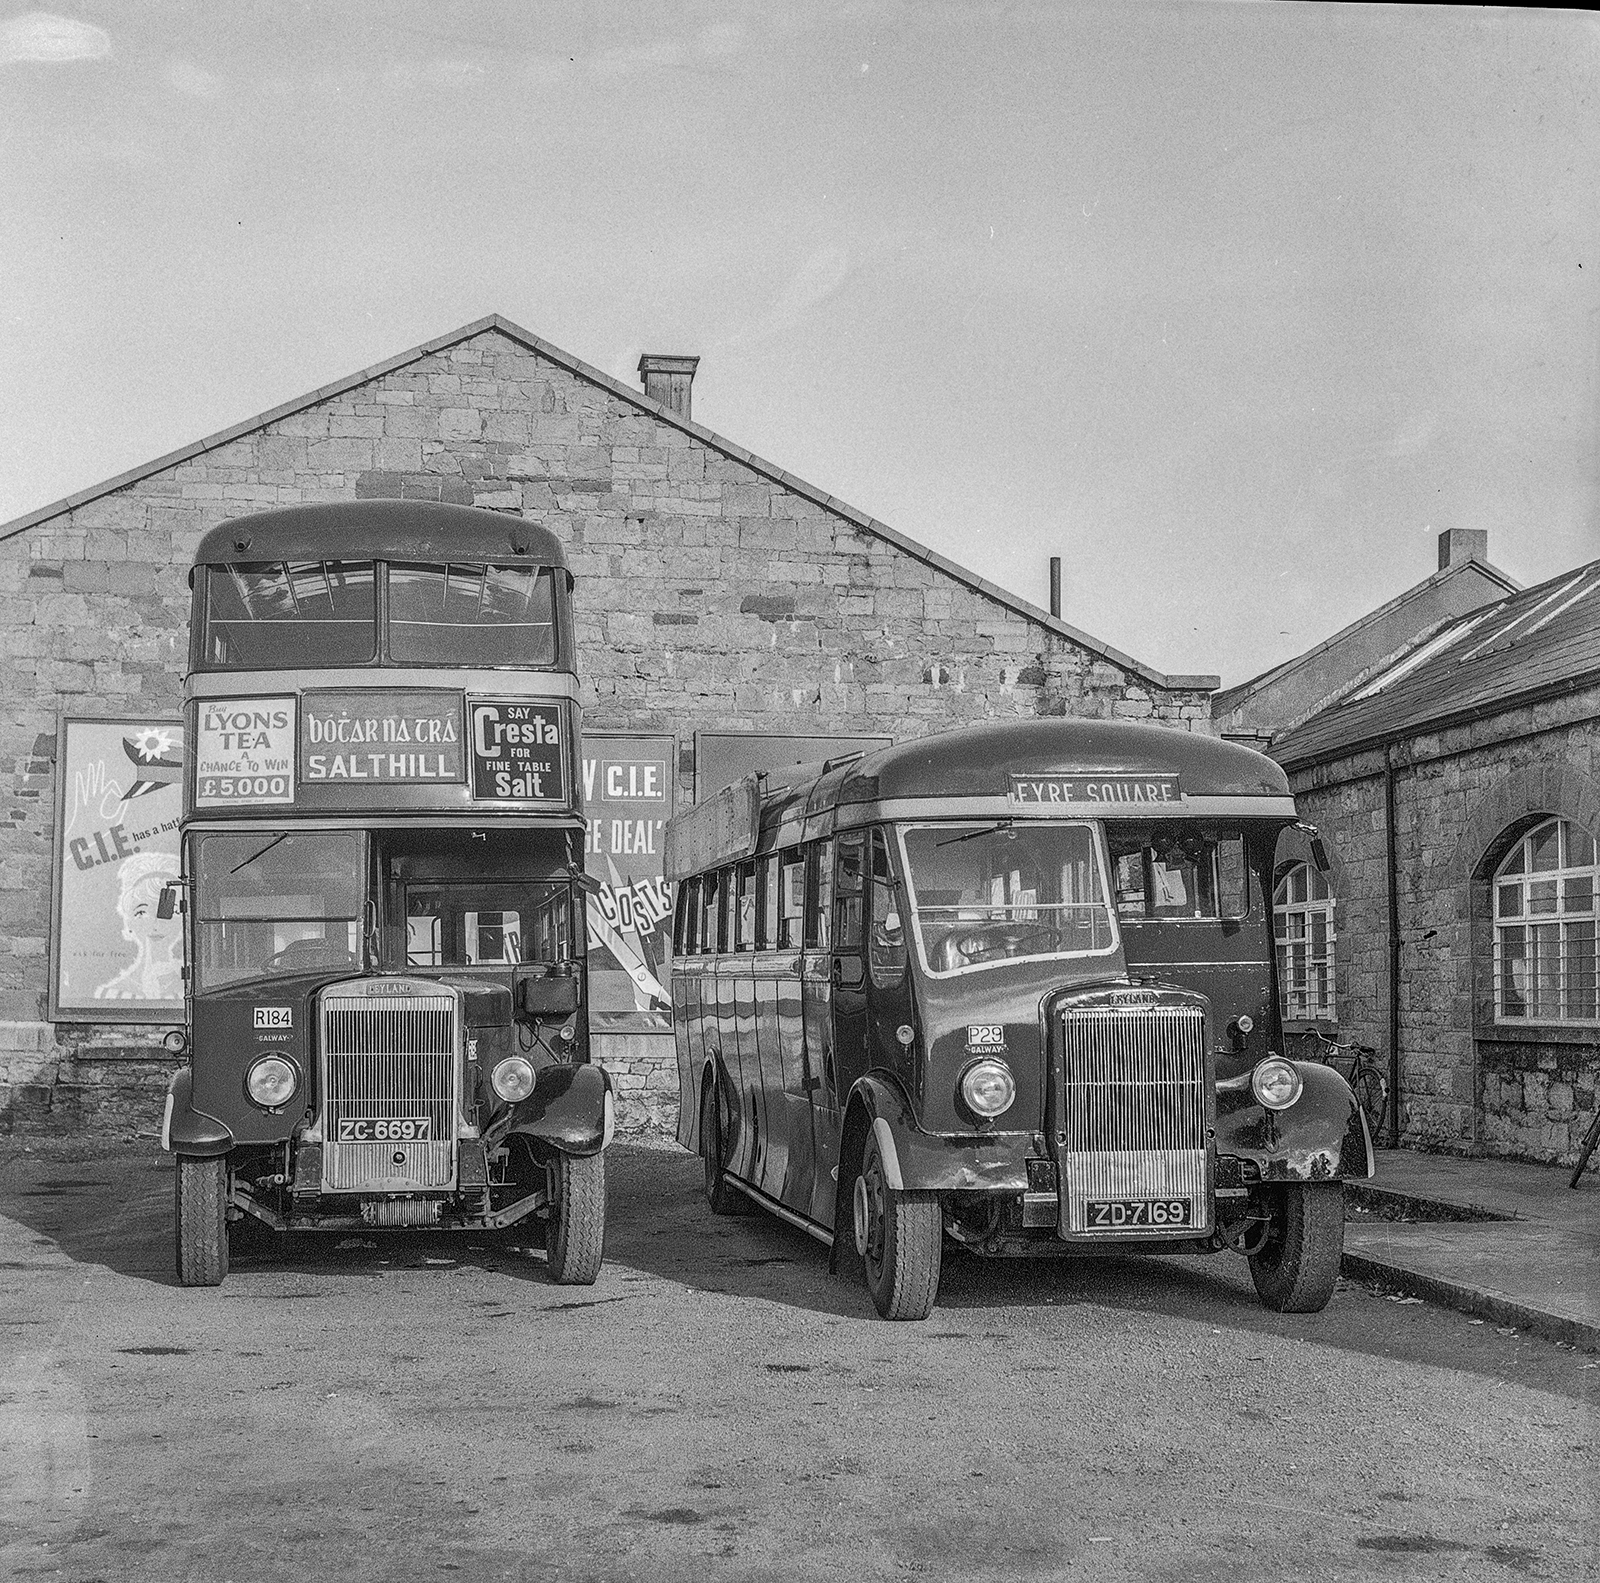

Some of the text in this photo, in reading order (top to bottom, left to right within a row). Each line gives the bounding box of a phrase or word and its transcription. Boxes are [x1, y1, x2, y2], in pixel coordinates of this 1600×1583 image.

[204, 711, 288, 731] LYONS
[507, 707, 530, 719] SAY
[219, 732, 271, 750] TEA
[474, 706, 559, 758] Cresta
[241, 751, 250, 760] A
[510, 748, 530, 758] FOR
[200, 759, 289, 773] CHANCE TO WIN
[308, 753, 456, 779] SALTHILL
[486, 761, 552, 772] FINE TABLE
[495, 772, 544, 797] Salt
[607, 765, 662, 797] C.I.E.
[1017, 783, 1172, 802] EYRE SQUARE
[69, 824, 140, 871] C.I.E.
[132, 831, 151, 842] has
[598, 881, 673, 932] COSTS
[255, 1010, 290, 1025] R184
[258, 1034, 287, 1042] GALWAY
[969, 1026, 1002, 1043] P29
[970, 1045, 1001, 1054] GALWAY
[341, 1121, 429, 1140] ZC-6697
